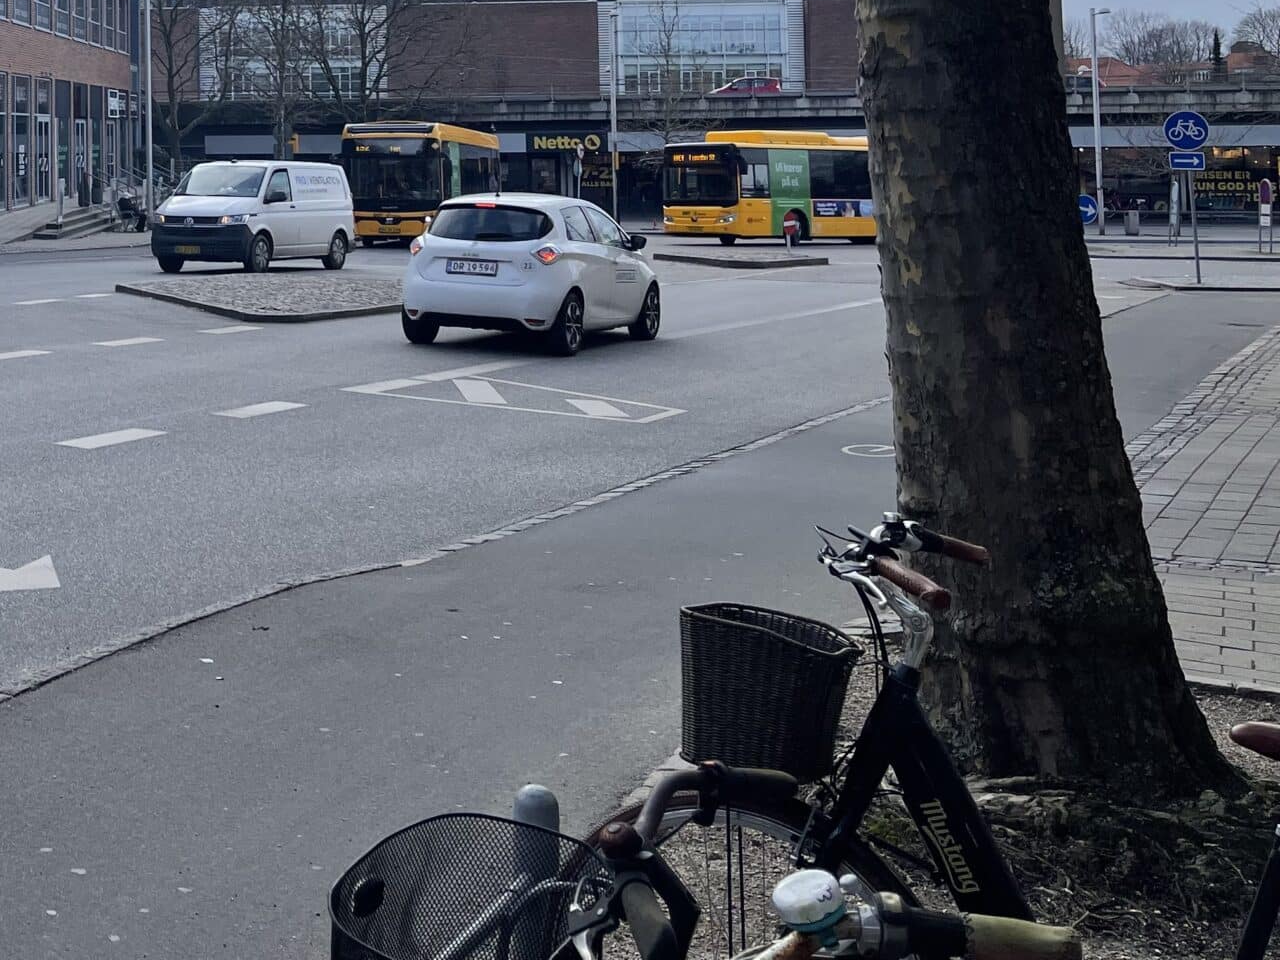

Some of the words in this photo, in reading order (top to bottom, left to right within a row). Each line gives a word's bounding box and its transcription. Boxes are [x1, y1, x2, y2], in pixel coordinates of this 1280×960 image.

[533, 136, 583, 150] Netto
[583, 166, 613, 179] 7-2
[1217, 182, 1245, 191] GOD
[452, 262, 465, 272] DR
[920, 798, 981, 893] Mustang
